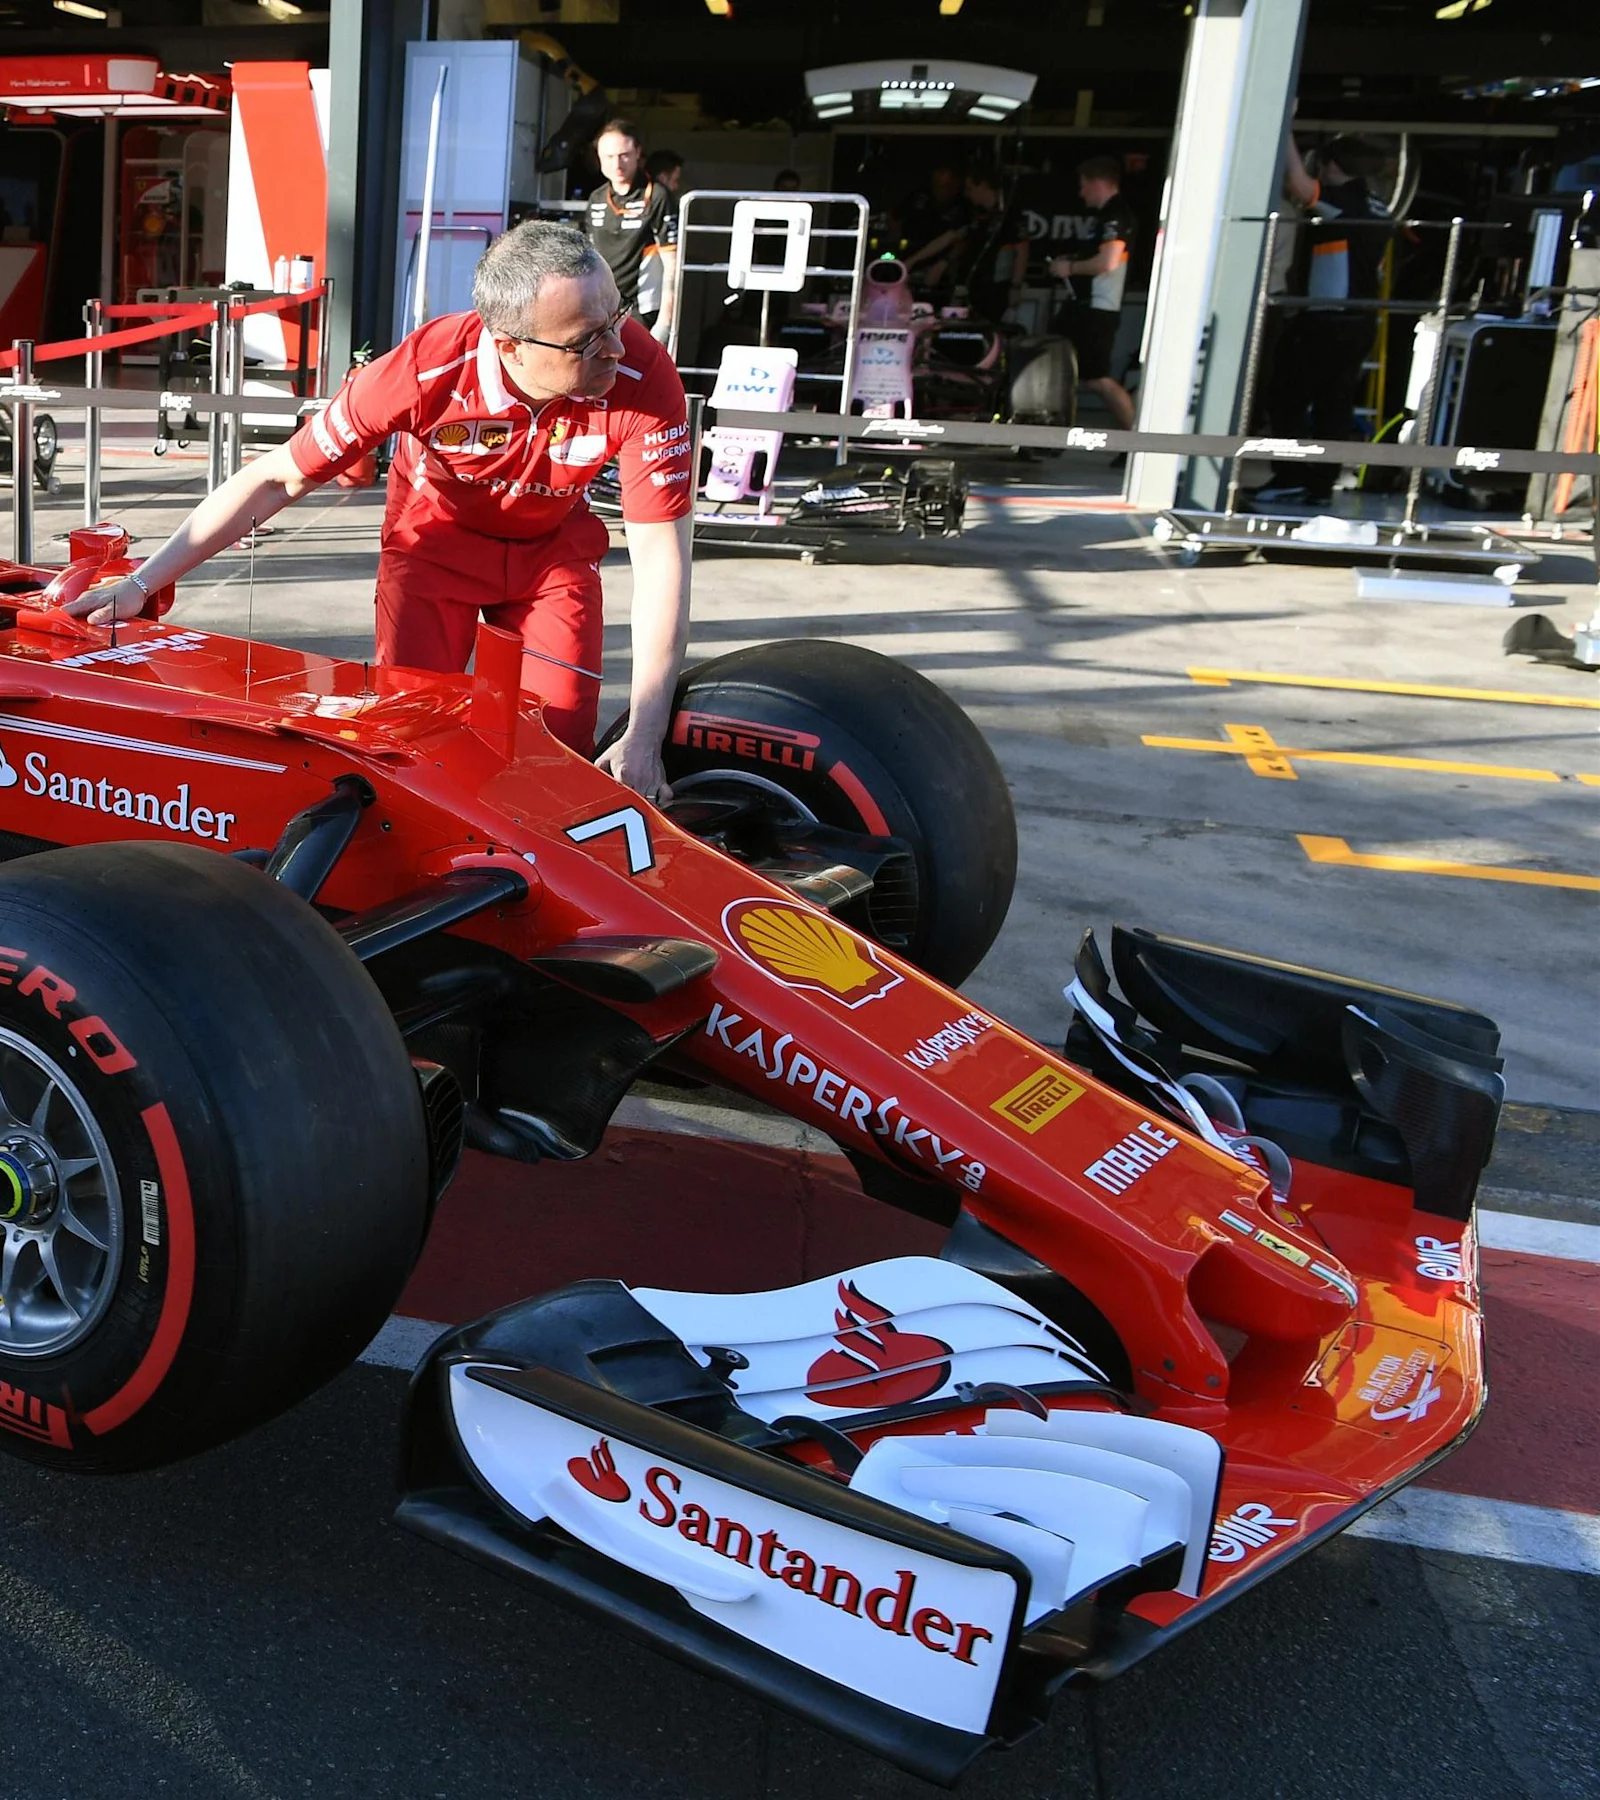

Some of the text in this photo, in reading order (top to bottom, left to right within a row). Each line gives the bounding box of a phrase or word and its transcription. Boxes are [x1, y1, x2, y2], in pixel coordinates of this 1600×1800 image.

[671, 710, 821, 771] PIRELLI
[22, 751, 236, 843] Santander
[562, 806, 655, 877] 7
[705, 1003, 964, 1171] KASPERSKY
[1004, 1074, 1073, 1125] PIRELLI
[1083, 1120, 1180, 1195] MAHLE
[1365, 1354, 1404, 1391] ACTION
[638, 1466, 994, 1666] Santander
